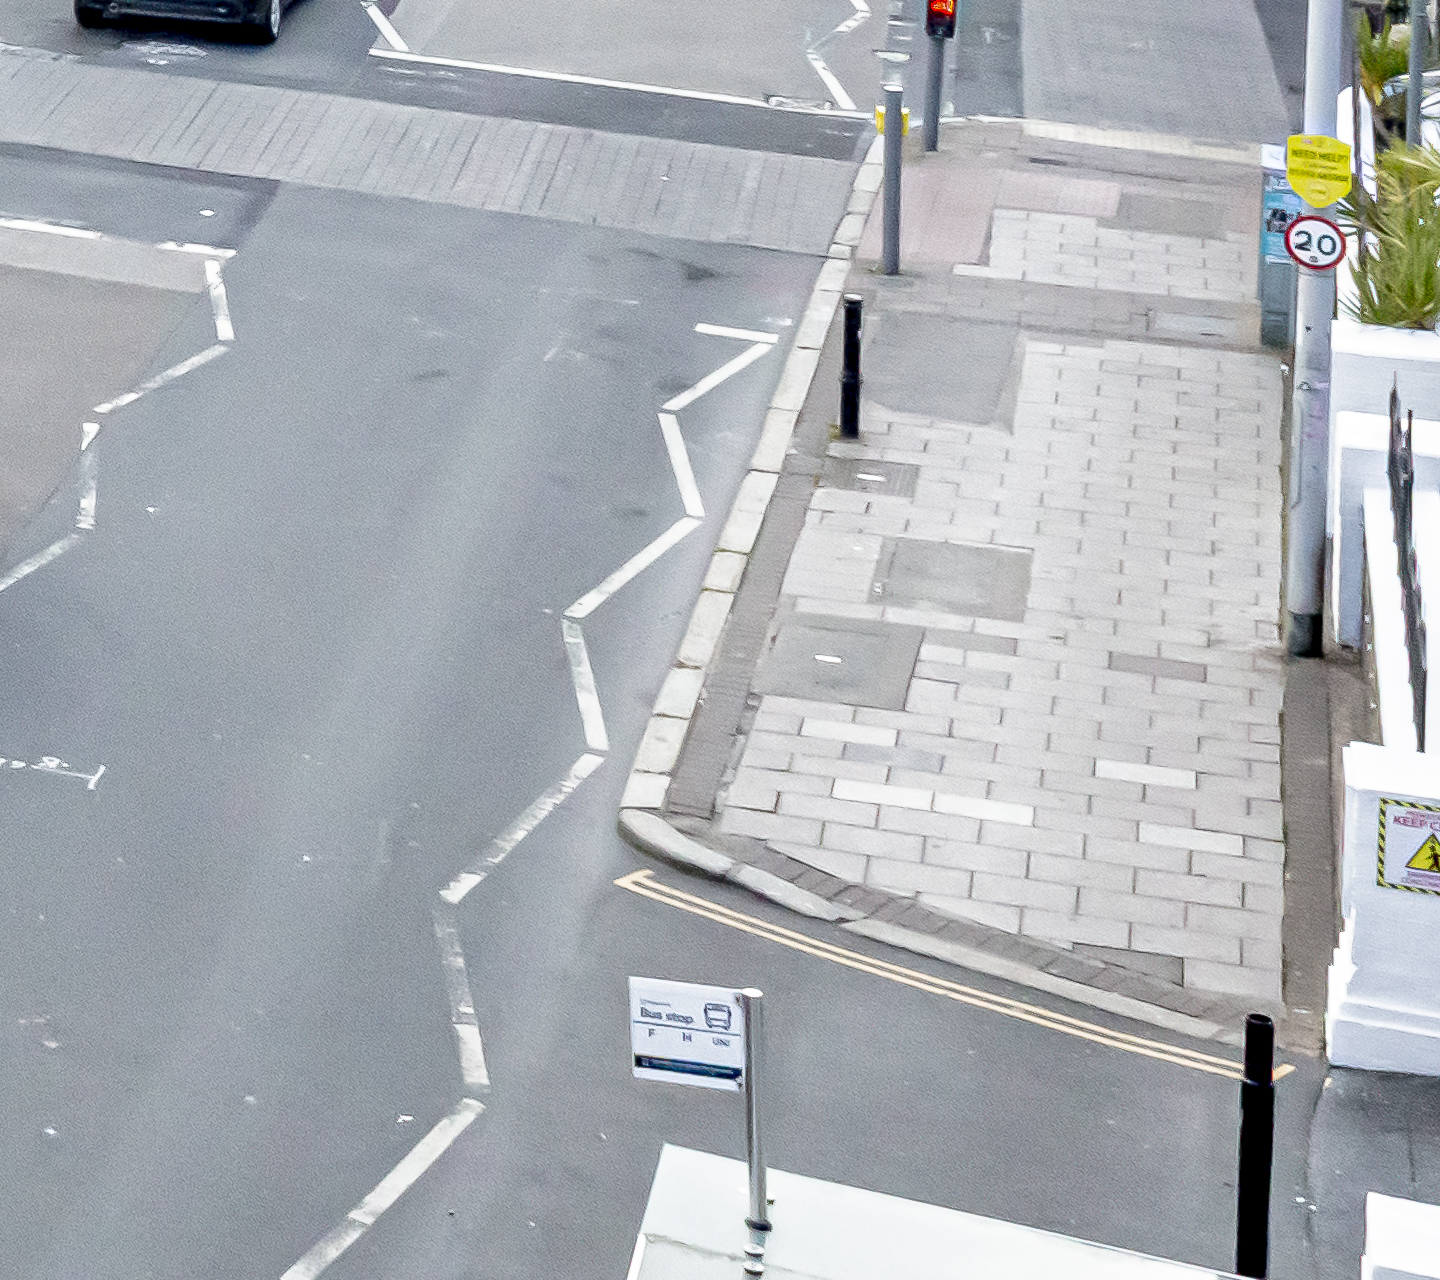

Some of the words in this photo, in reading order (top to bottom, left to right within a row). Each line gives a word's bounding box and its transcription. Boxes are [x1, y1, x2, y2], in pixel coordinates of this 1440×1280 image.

[1294, 230, 1337, 256] 20
[640, 1006, 663, 1020] Bus
[665, 1012, 694, 1025] stop
